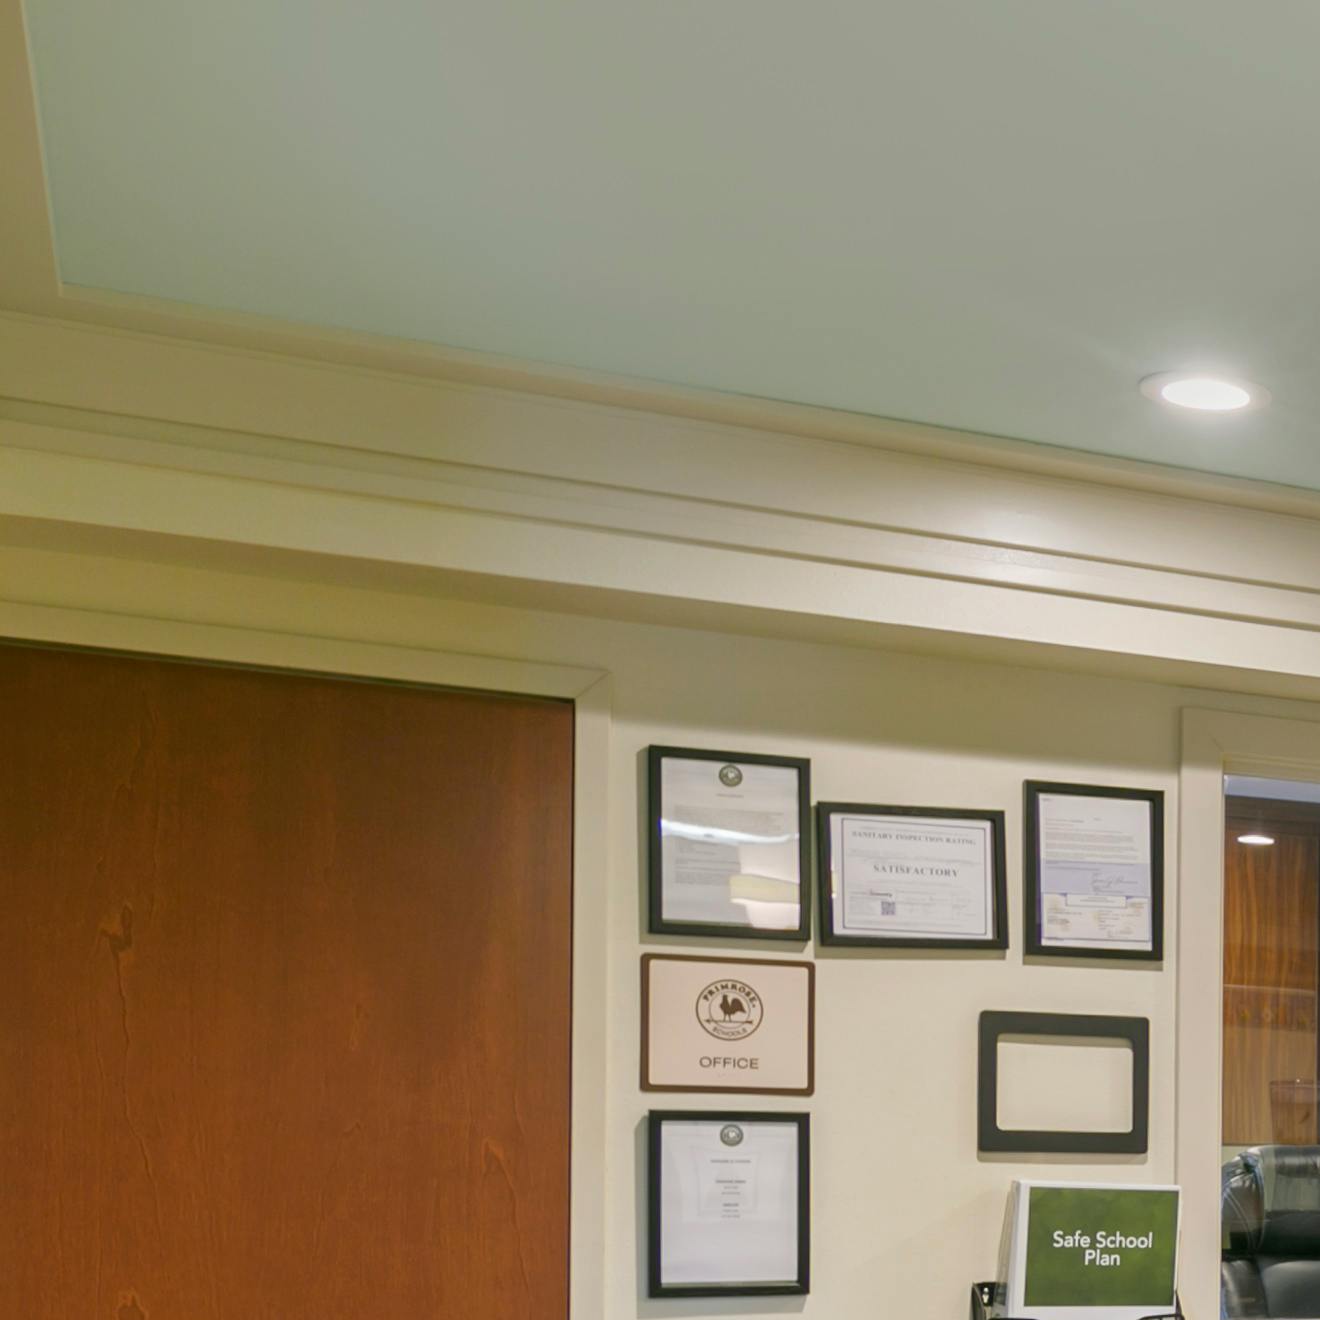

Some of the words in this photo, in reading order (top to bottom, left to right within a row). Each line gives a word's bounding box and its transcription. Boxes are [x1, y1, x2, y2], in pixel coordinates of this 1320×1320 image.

[873, 863, 960, 878] SATISFACTORY
[702, 982, 758, 1004] PRIMROSE
[698, 1056, 760, 1070] OFFICE
[1052, 1230, 1091, 1248] Safe
[1095, 1230, 1154, 1249] School
[1084, 1248, 1121, 1266] Plan
